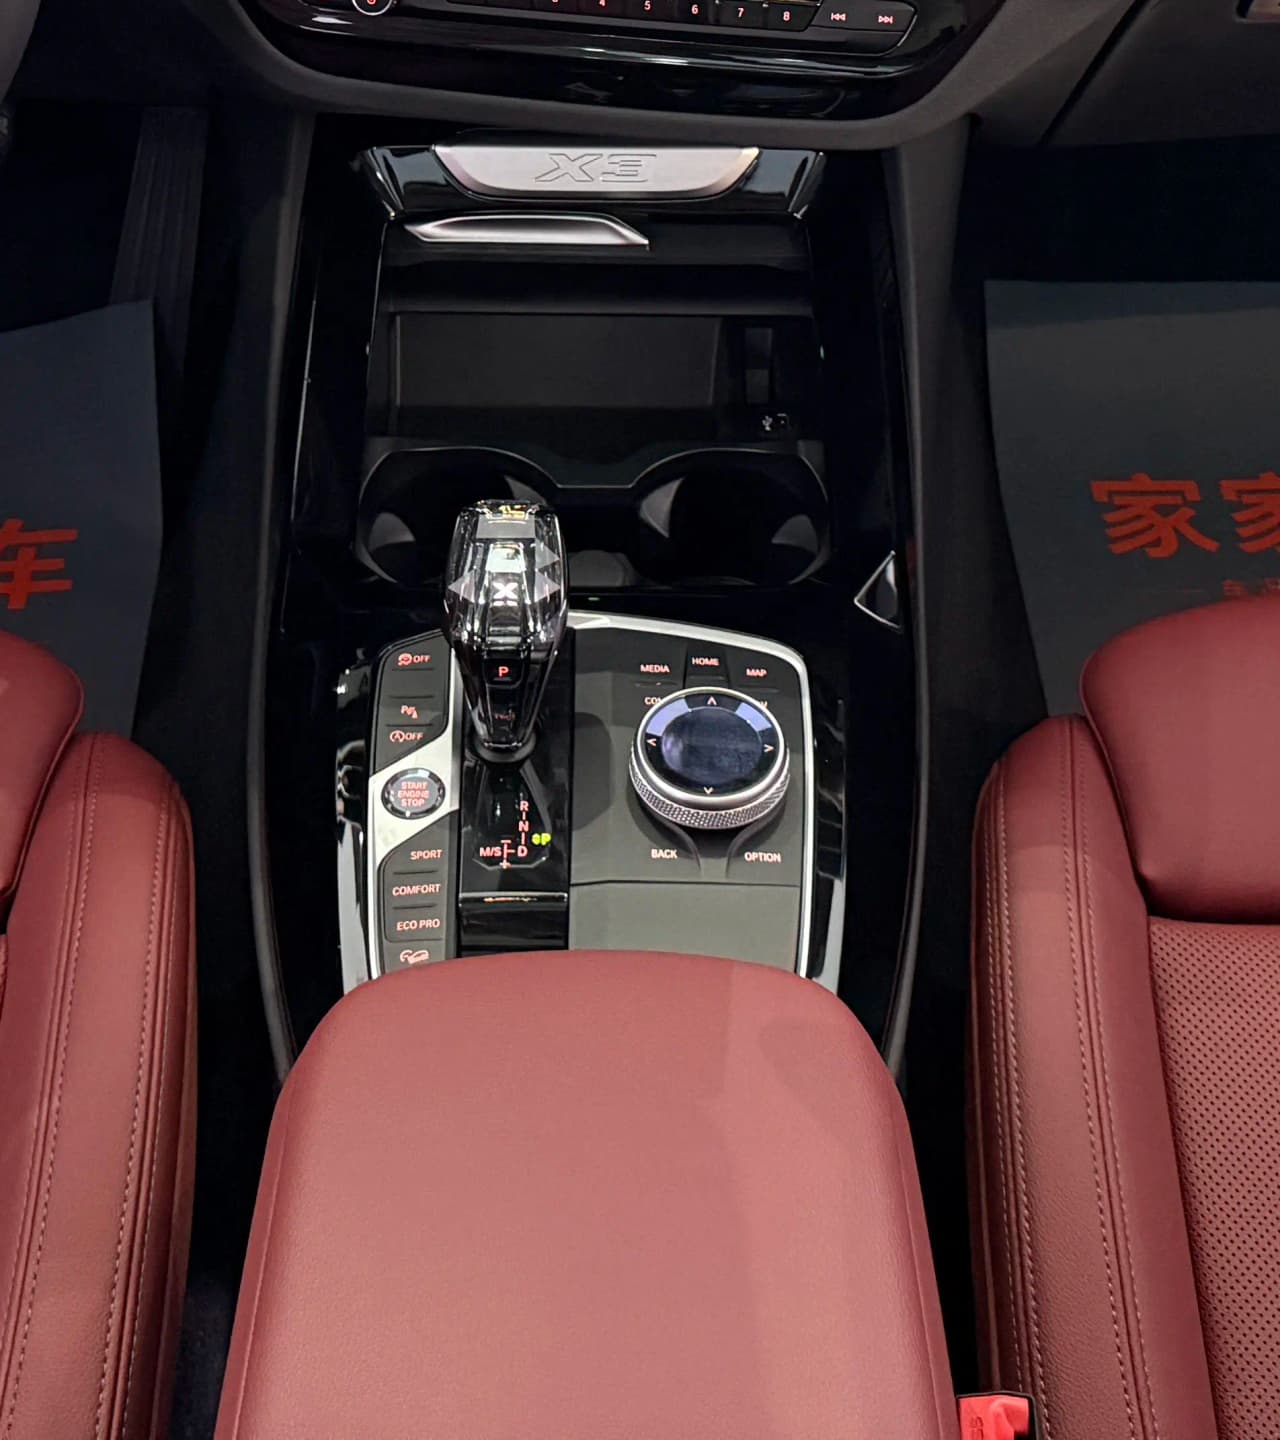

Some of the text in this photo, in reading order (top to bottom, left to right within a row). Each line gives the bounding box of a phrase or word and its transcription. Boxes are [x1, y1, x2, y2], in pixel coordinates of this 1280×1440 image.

[644, 0, 651, 11] 5
[691, 4, 698, 15] 6
[737, 7, 744, 18] 7
[783, 11, 790, 21] 8
[534, 153, 657, 182] X3
[413, 655, 431, 663] OFF
[691, 657, 720, 666] HOME
[498, 666, 509, 676] P
[640, 664, 670, 673] MEDIA
[746, 668, 767, 677] MAP
[404, 732, 424, 741] OFF
[401, 781, 428, 790] START
[397, 790, 429, 798] ENGINE
[401, 798, 425, 807] STOP
[520, 801, 529, 811] R
[519, 820, 529, 831] N
[410, 849, 442, 860] SPORT
[479, 845, 528, 857] M/S D
[651, 849, 677, 859] BACK
[744, 852, 781, 862] OPTION
[392, 884, 441, 896] COMFORT
[396, 918, 440, 931] ECO PRO
